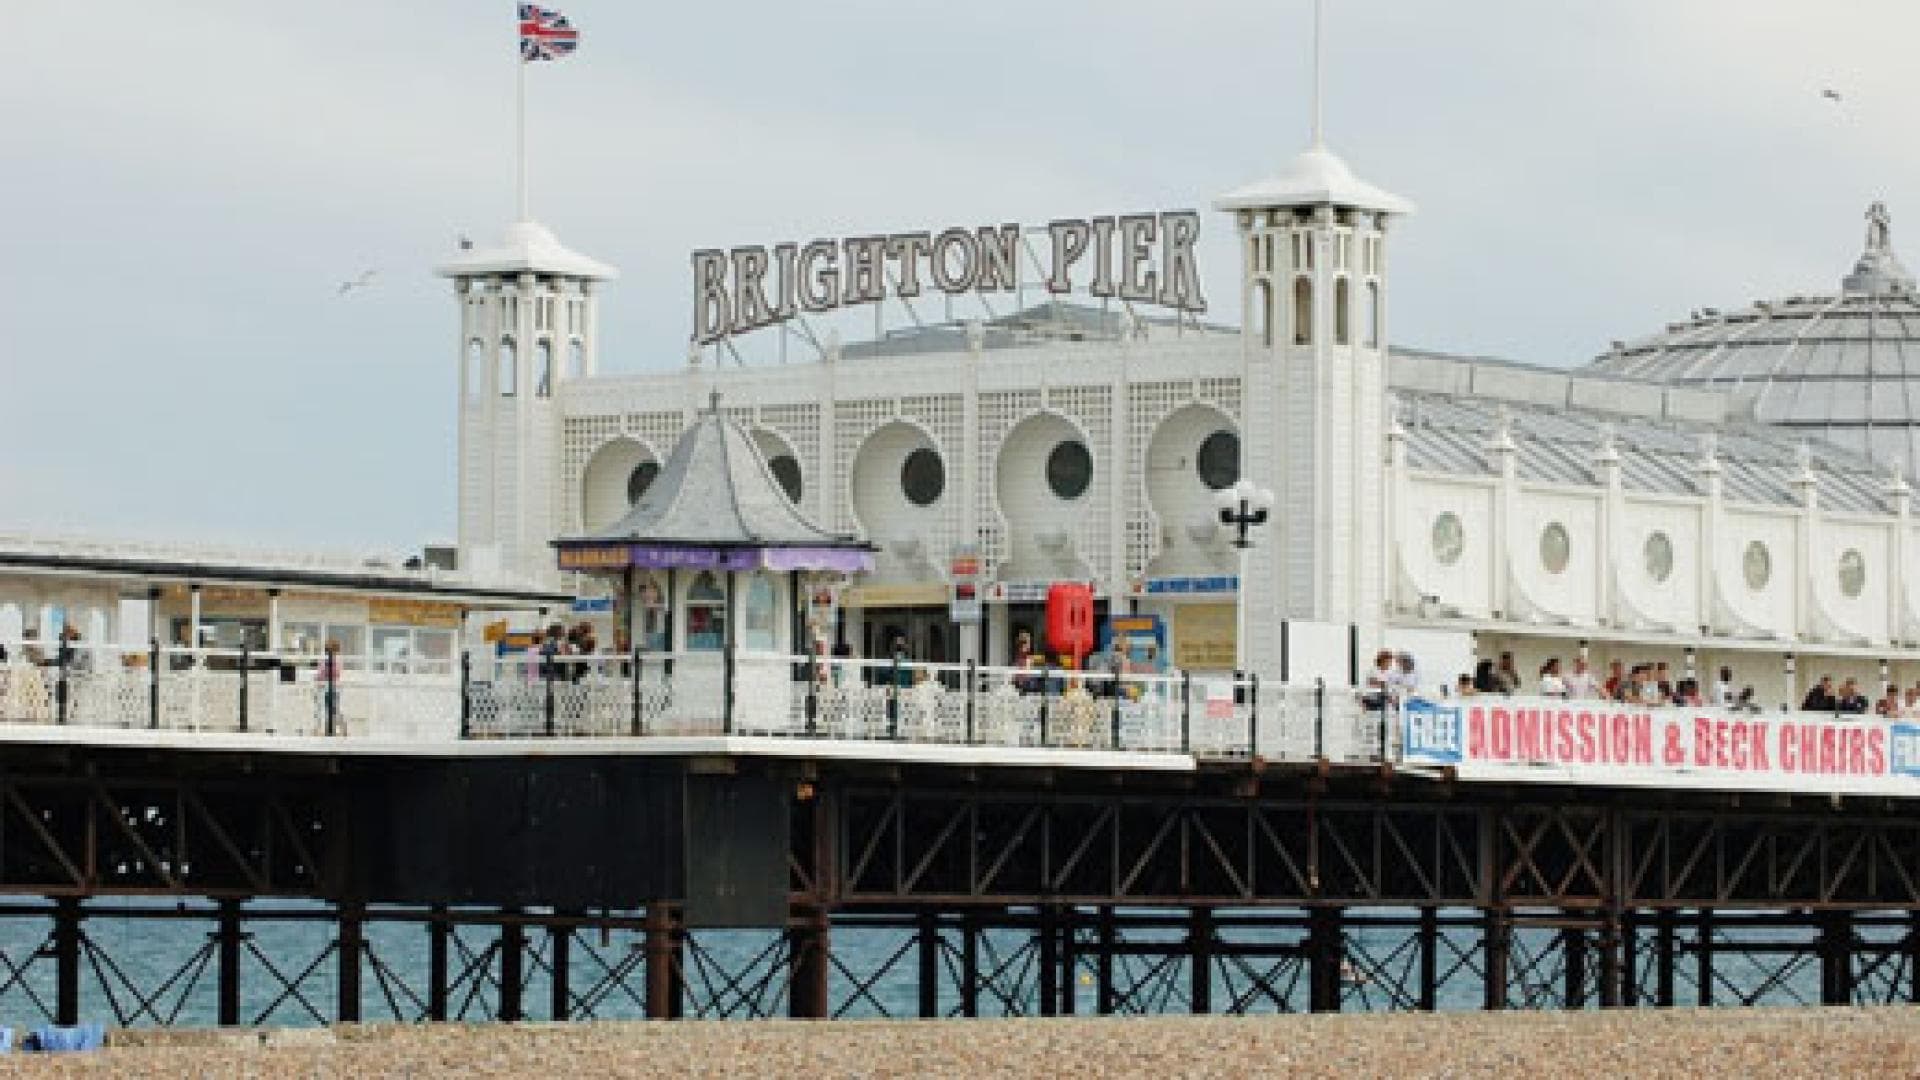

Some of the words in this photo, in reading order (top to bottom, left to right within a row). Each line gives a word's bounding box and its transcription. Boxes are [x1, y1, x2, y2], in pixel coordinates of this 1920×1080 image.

[690, 222, 1020, 346] BRIGHTON
[1047, 208, 1208, 313] PIER
[1409, 712, 1459, 751] FREE
[1468, 706, 1652, 765] ADMISSION
[1661, 720, 1686, 766] &
[1693, 716, 1770, 771] DECK
[1779, 723, 1884, 776] CHAIRS
